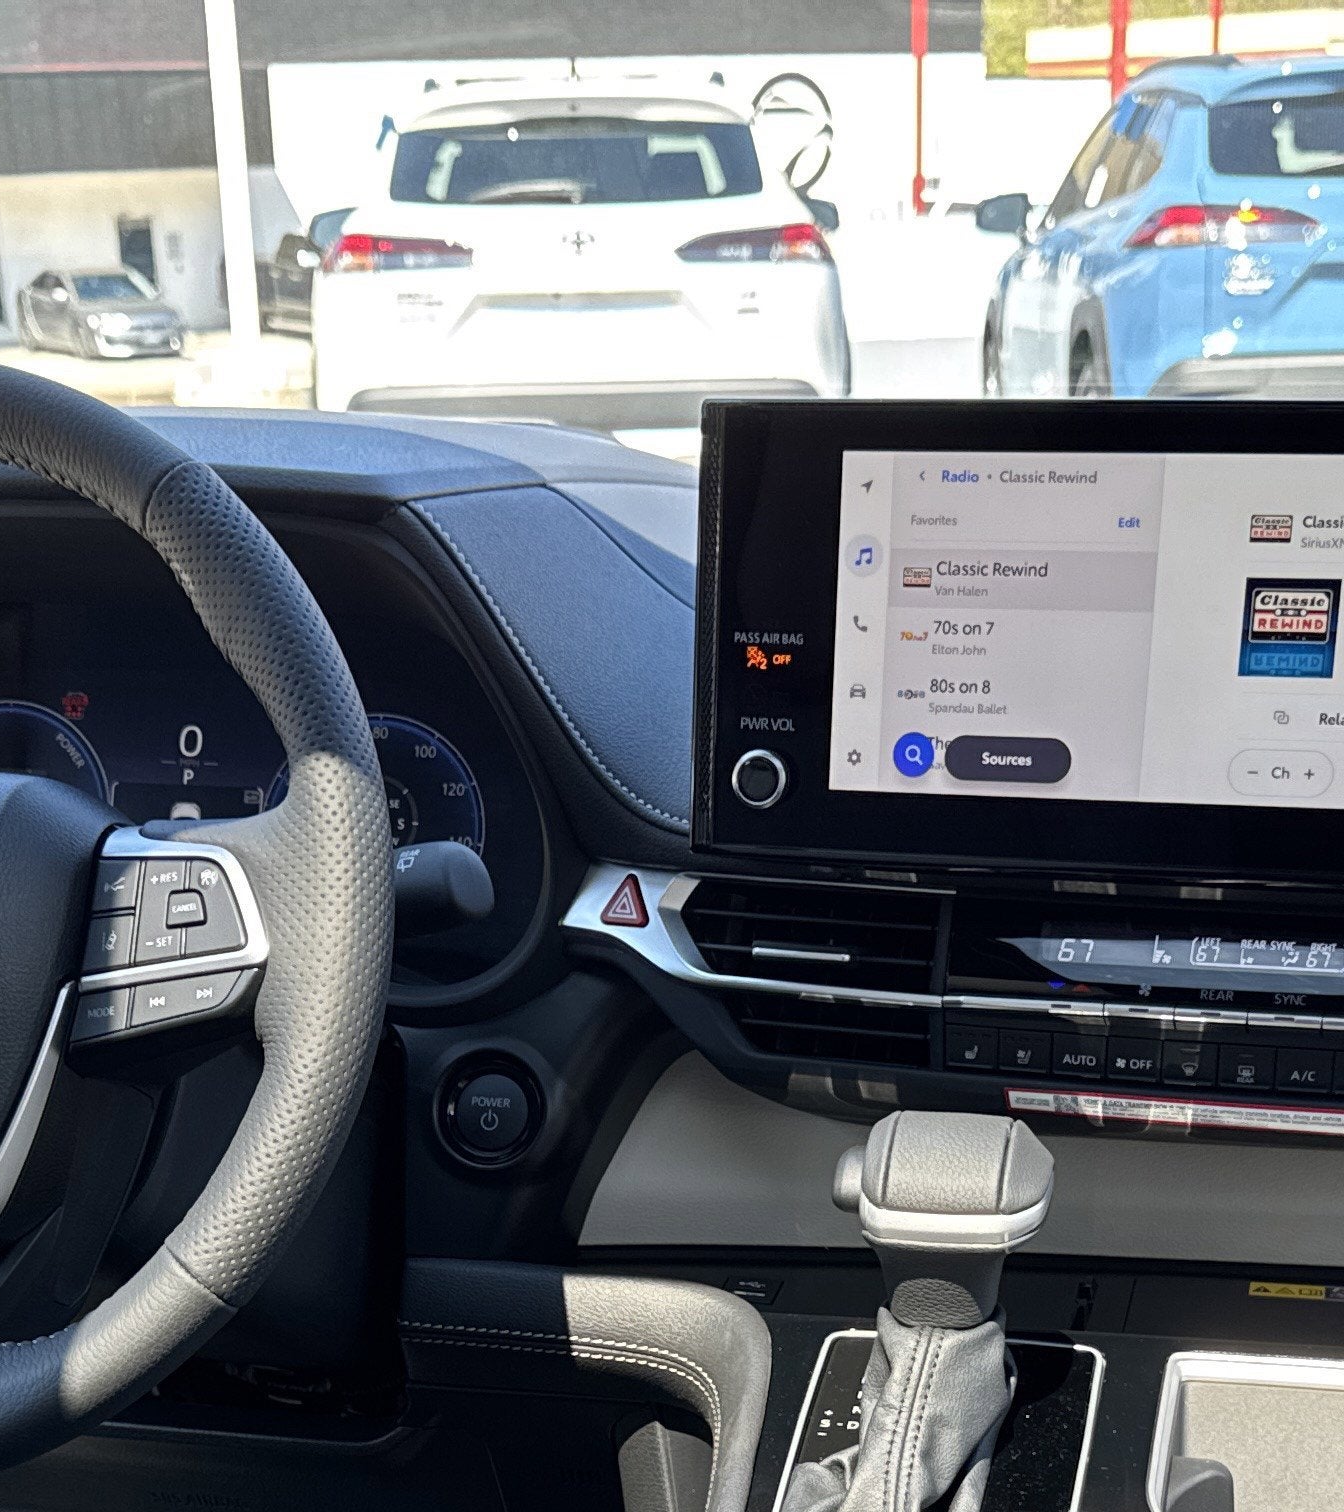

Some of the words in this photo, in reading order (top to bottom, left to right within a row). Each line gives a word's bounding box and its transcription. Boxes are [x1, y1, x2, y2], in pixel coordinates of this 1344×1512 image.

[941, 469, 980, 484] Radio
[999, 469, 1045, 484] Classic
[1048, 470, 1098, 485] Rewind
[910, 514, 958, 526] Favorites
[1117, 516, 1141, 528] Edit
[936, 561, 988, 577] Classic
[992, 562, 1048, 578] Rewind
[935, 585, 954, 596] Van
[957, 586, 988, 597] Halen
[1260, 594, 1326, 607] Classic
[933, 620, 959, 635] 70s
[962, 623, 982, 636] on
[985, 621, 995, 636] 7
[1257, 618, 1324, 630] REWIND
[734, 631, 760, 644] PASS
[762, 632, 780, 644] AIR
[782, 632, 804, 645] BAG
[931, 644, 959, 656] Elton
[960, 644, 987, 657] John
[772, 654, 792, 665] OFF
[929, 678, 955, 694] 80s
[958, 682, 978, 695] on
[981, 680, 991, 695] 8
[928, 702, 975, 716] Spandau
[977, 702, 1008, 715] Ballet
[740, 716, 769, 730] PWR
[771, 718, 795, 732] VOL
[178, 724, 204, 758] 0
[56, 732, 86, 769] POWER
[414, 744, 437, 759] 100
[981, 752, 1033, 767] Sources
[182, 768, 195, 785] P
[1271, 767, 1290, 780] Ch
[442, 782, 466, 797] 120
[171, 902, 197, 914] CANCEL
[1200, 937, 1222, 947] LEFT
[1240, 939, 1267, 950] REAR
[1269, 940, 1296, 951] SYNC
[1310, 942, 1337, 953] RIGHT
[1057, 938, 1094, 963] 67
[1196, 945, 1220, 962] 67
[1305, 950, 1331, 968] 67
[1199, 989, 1234, 1002] REAR
[1274, 992, 1307, 1006] SYNC
[87, 1005, 115, 1019] MODE
[1062, 1053, 1097, 1066] AUTO
[1129, 1058, 1153, 1070] OFF
[1290, 1070, 1316, 1082] A/C
[471, 1095, 511, 1109] POWER
[846, 1420, 860, 1430] D
